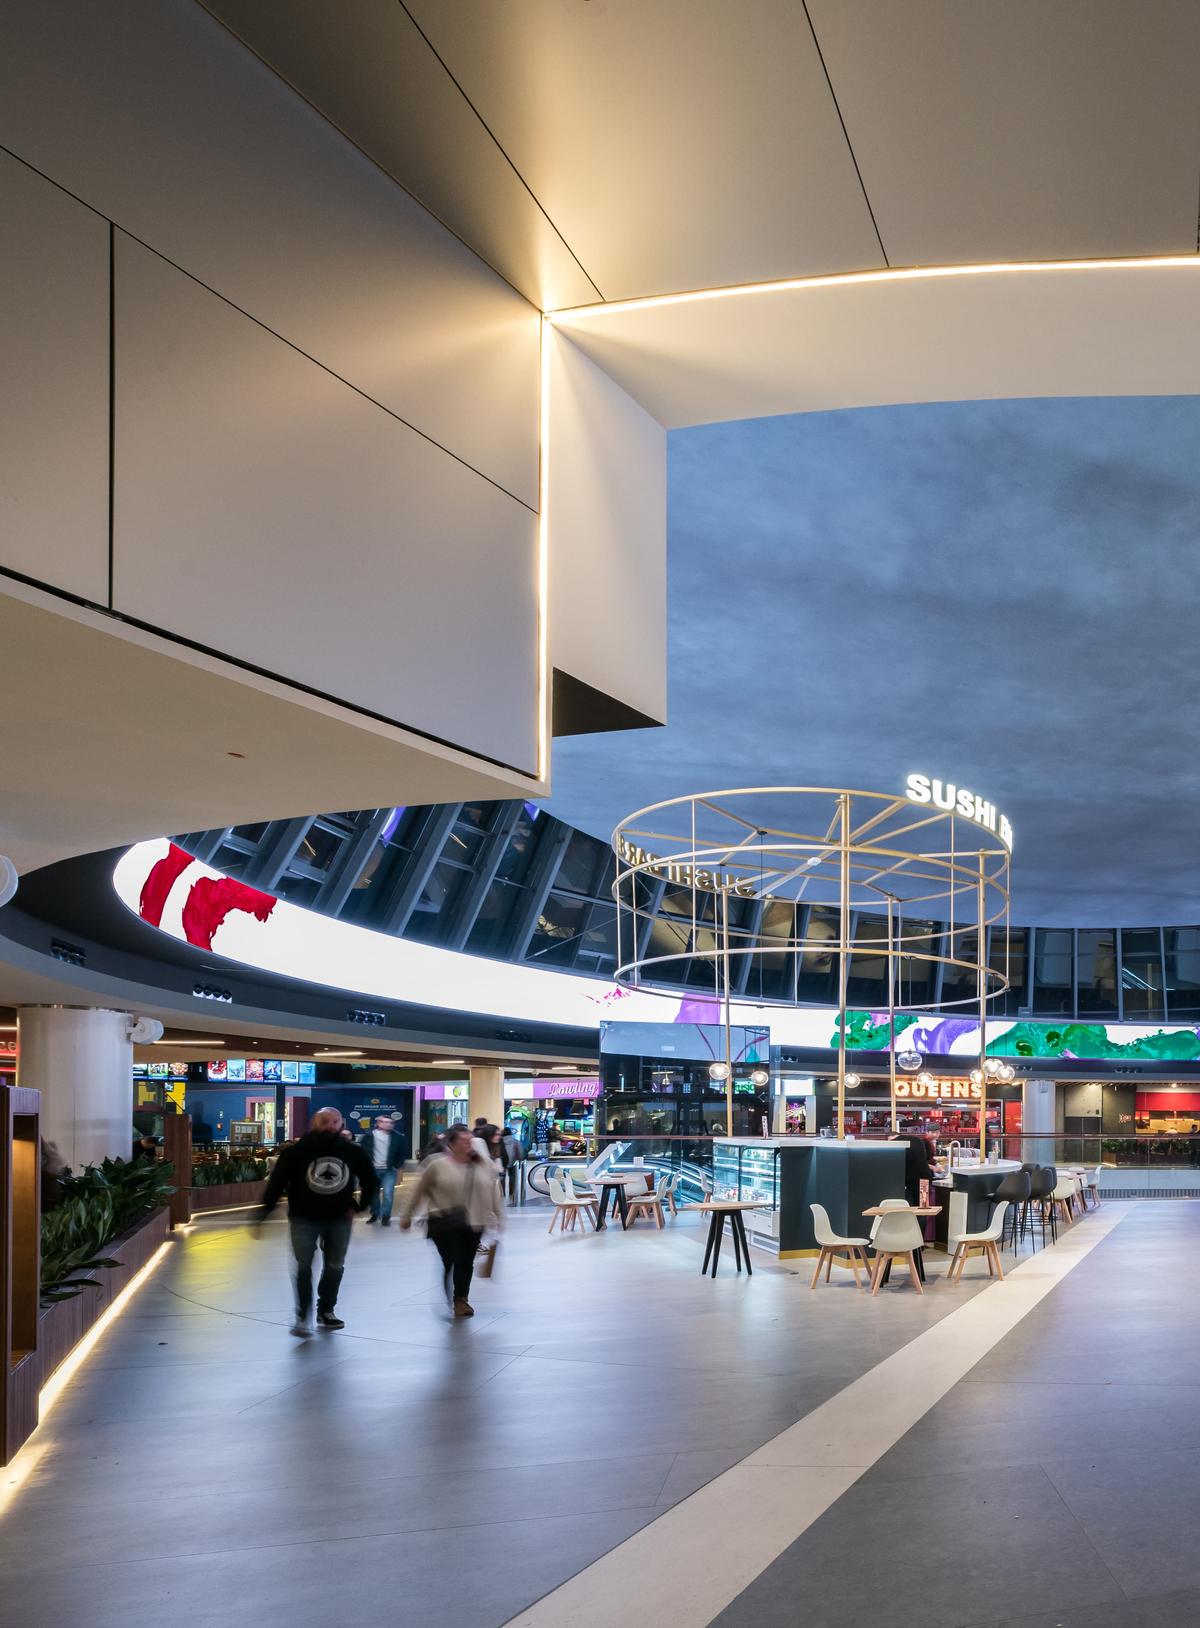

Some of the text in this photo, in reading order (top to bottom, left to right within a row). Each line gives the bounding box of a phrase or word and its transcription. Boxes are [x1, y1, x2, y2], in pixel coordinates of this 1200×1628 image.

[906, 774, 995, 831] SUSHI
[549, 1082, 598, 1096] Bowling
[895, 1081, 981, 1097] QUEENS
